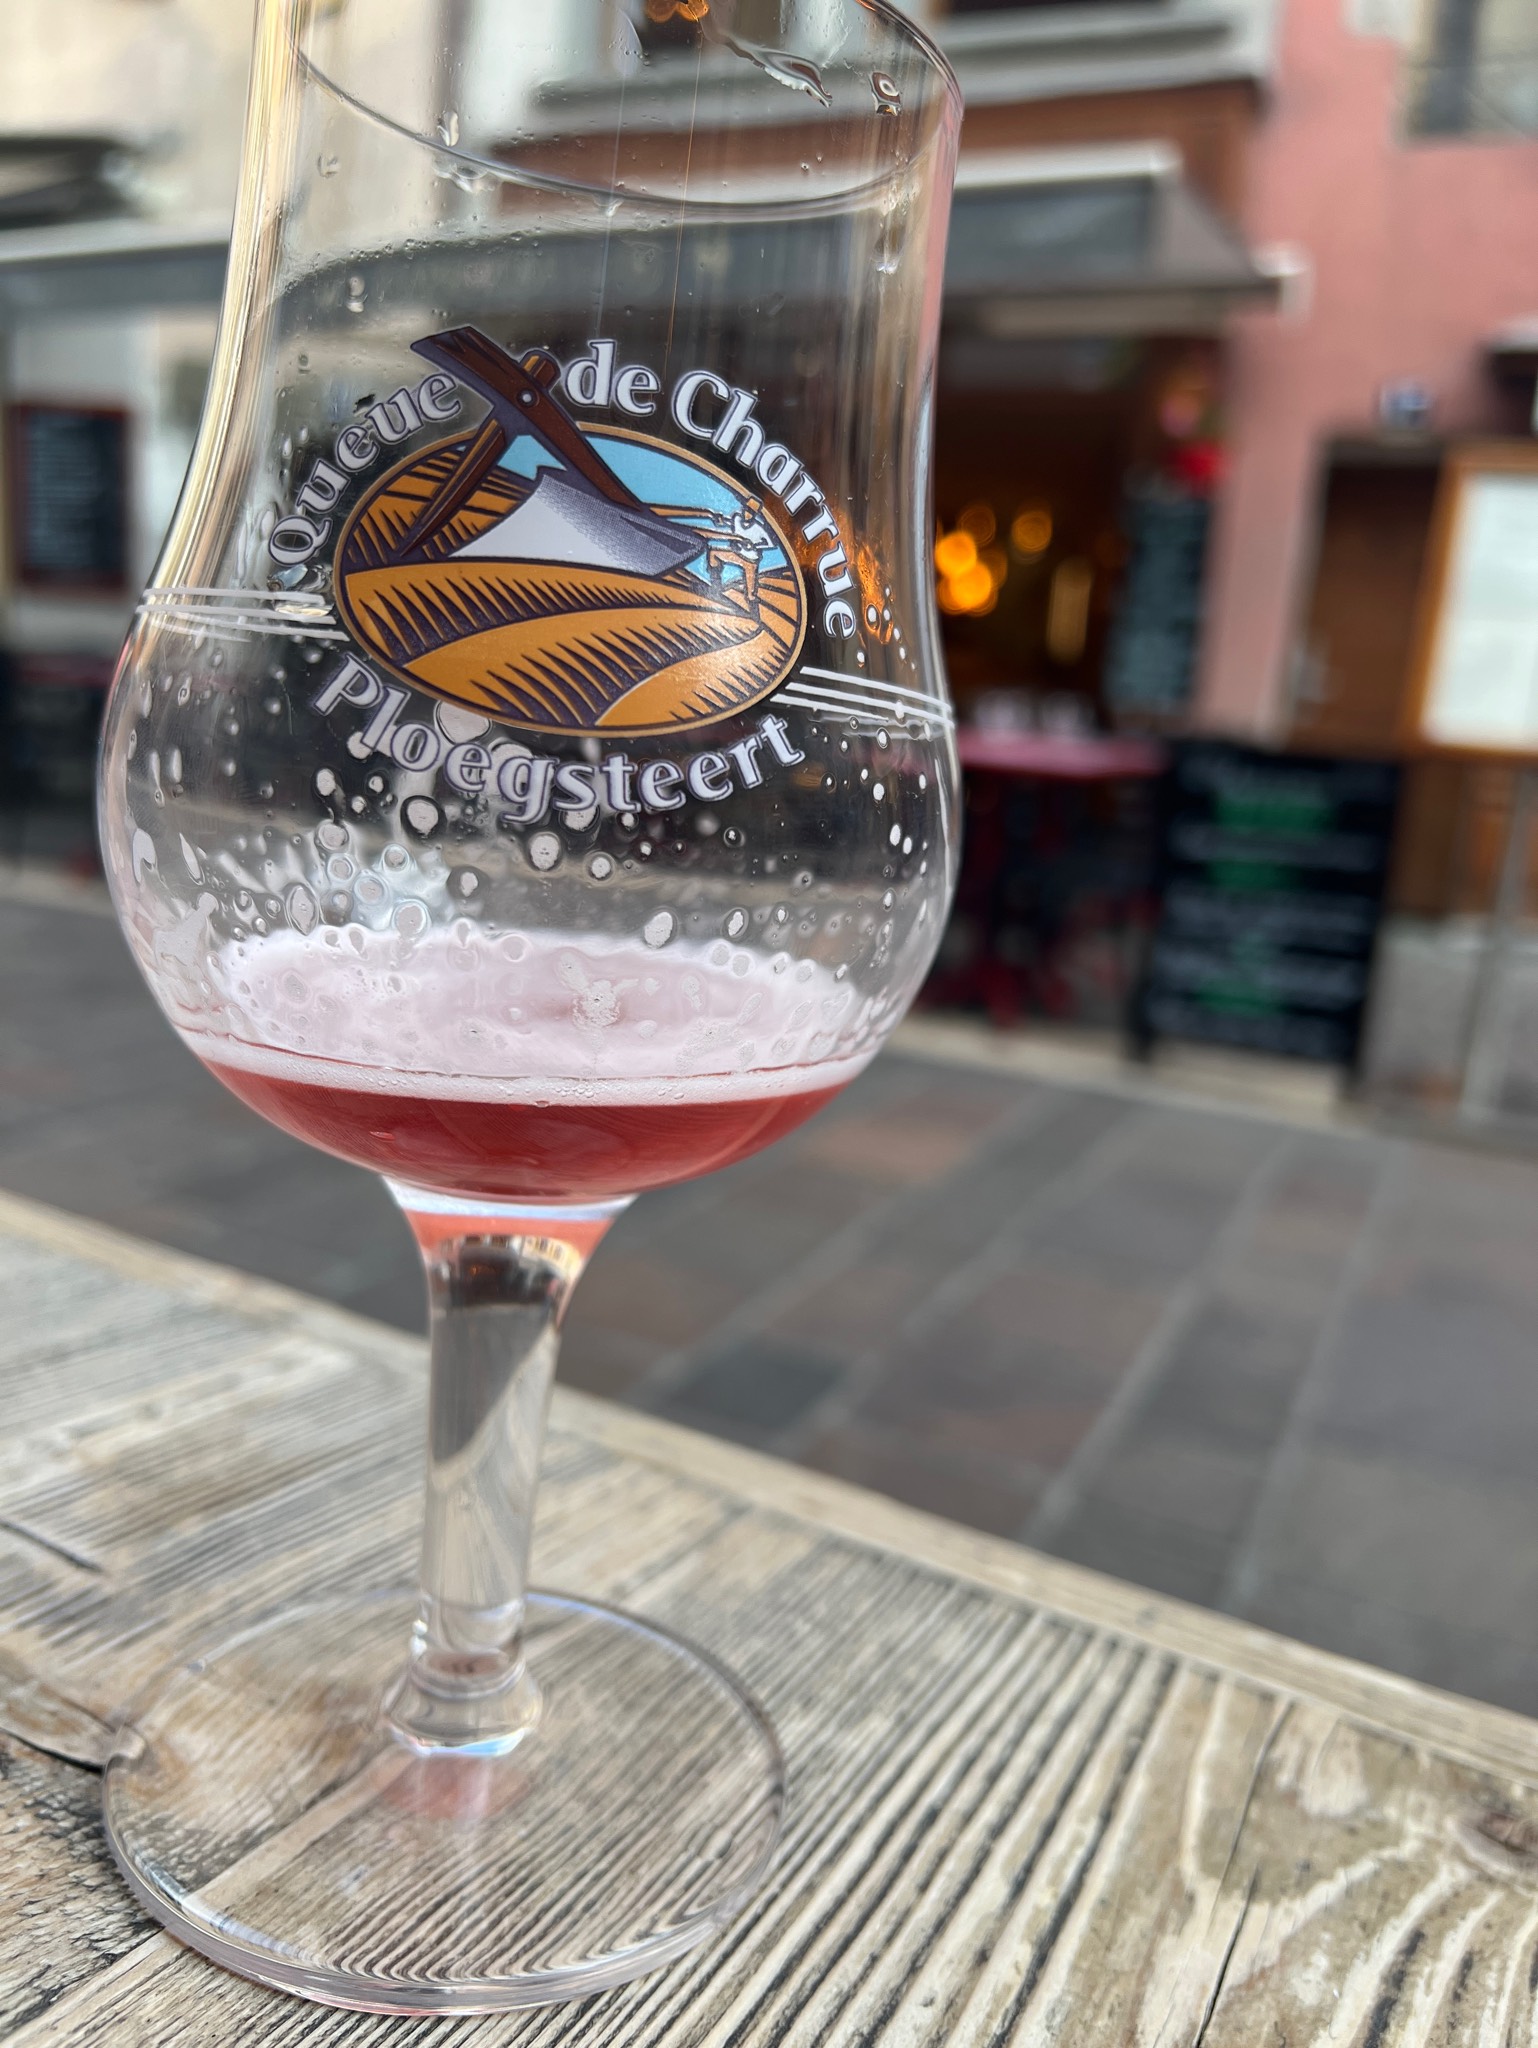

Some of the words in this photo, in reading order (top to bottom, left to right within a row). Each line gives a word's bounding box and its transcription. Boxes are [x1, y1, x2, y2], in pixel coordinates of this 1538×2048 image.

[267, 371, 462, 567] Queue
[564, 339, 659, 416] de
[673, 371, 857, 639] Charrue
[313, 654, 805, 823] Ploegsteert
